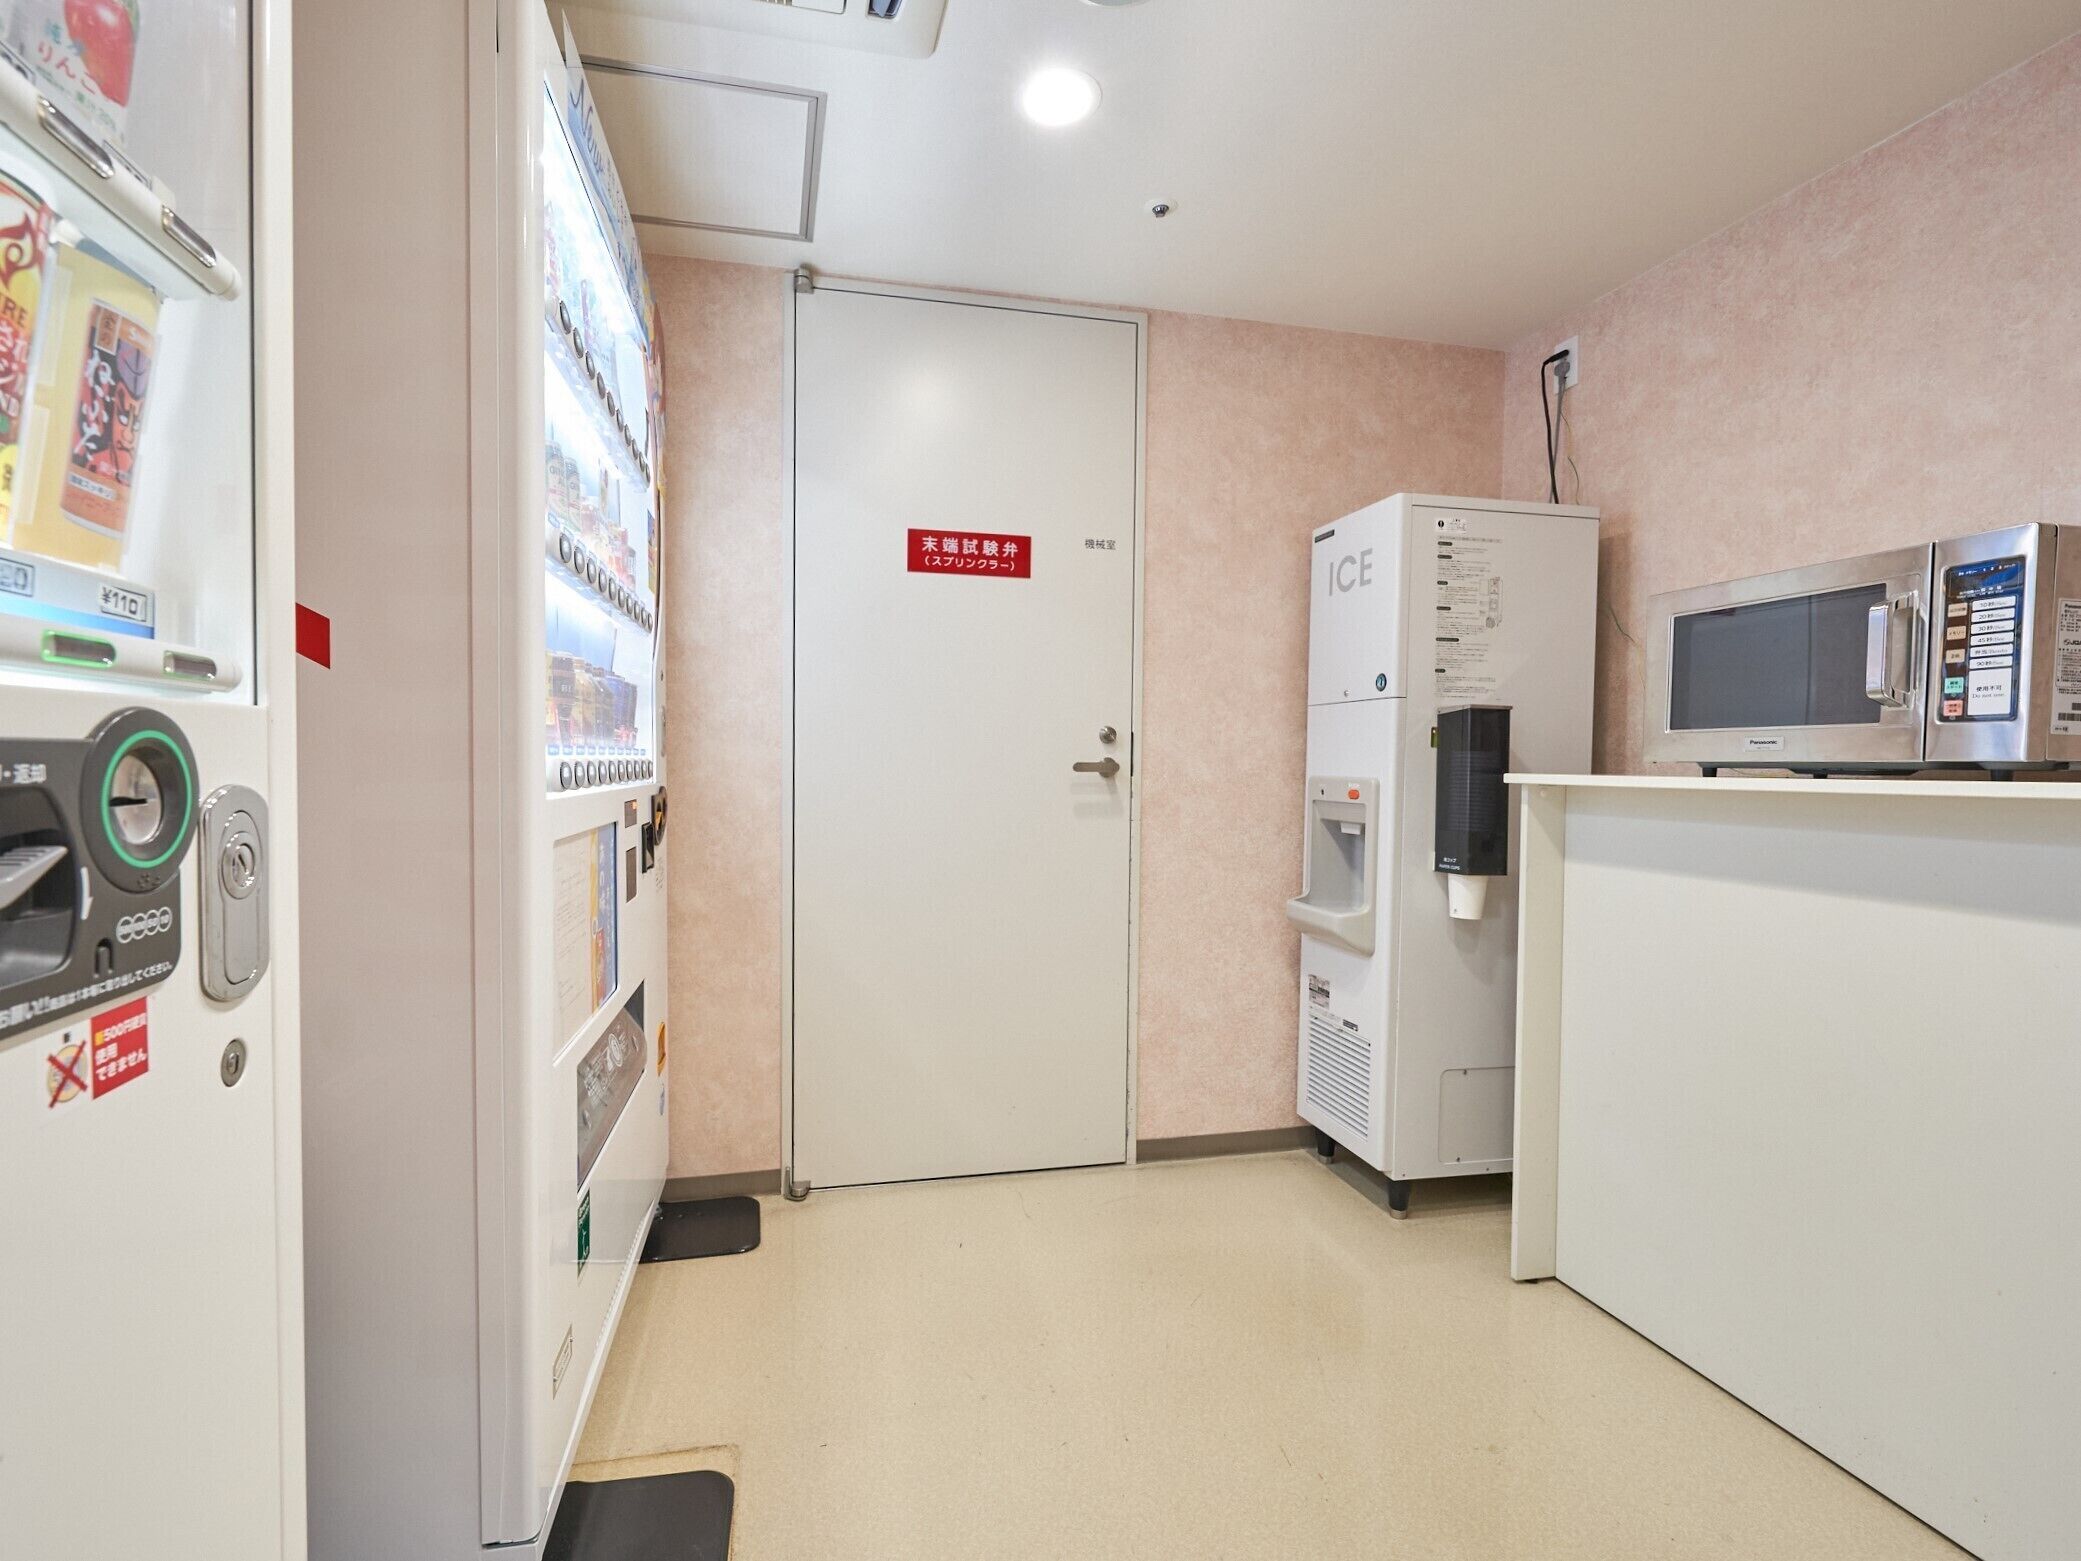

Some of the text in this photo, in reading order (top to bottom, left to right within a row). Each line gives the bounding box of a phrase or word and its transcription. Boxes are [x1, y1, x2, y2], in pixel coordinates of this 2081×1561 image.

[921, 535, 1019, 558] 末端試験弁
[1084, 538, 1117, 551] 機械室
[924, 555, 1016, 572] （スプリンクラー）
[1328, 548, 1373, 597] ICE
[102, 586, 138, 616] ¥110
[96, 1042, 118, 1066] 使用
[96, 1047, 147, 1080] できません
